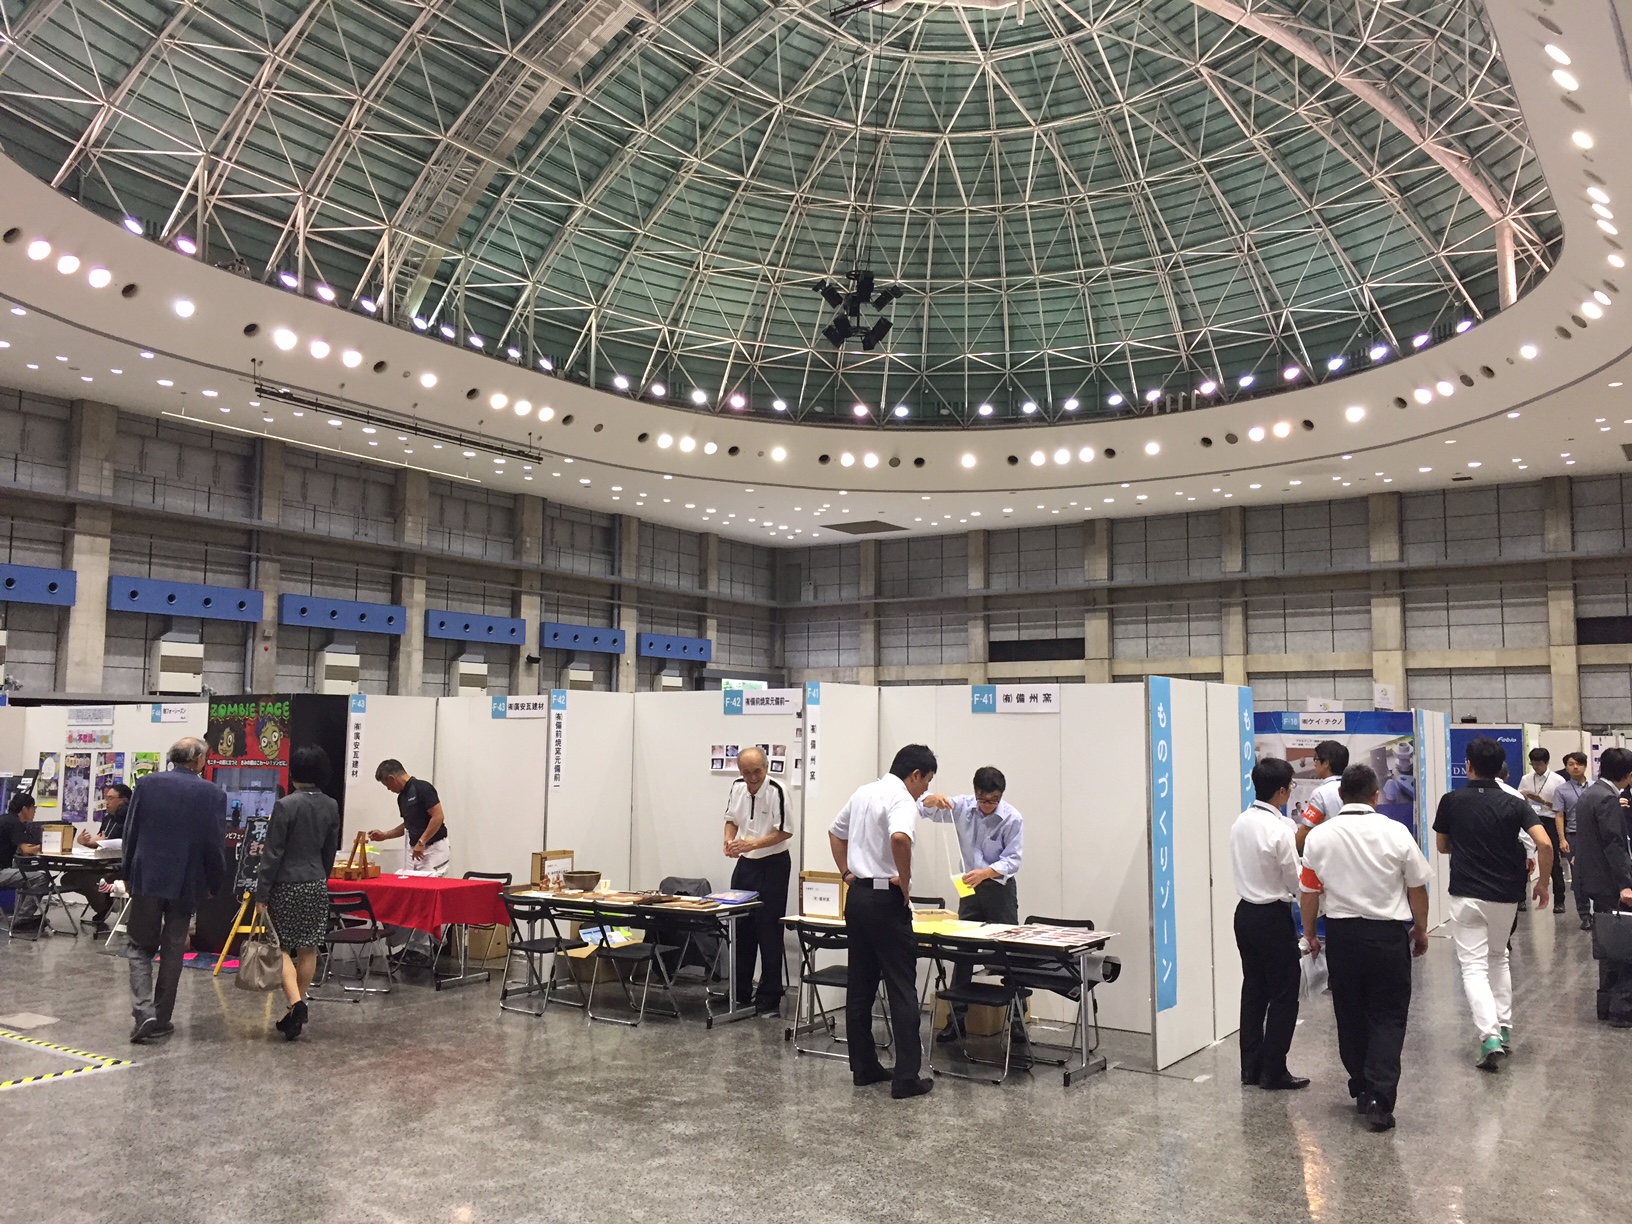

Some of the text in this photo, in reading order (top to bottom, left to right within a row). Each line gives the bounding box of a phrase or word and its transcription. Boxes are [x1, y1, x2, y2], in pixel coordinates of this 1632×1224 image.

[351, 699, 365, 708] F-43
[552, 694, 566, 705] F-42
[725, 697, 741, 707] F-42
[973, 693, 993, 705] F-41
[210, 701, 290, 718] ZOMBIE FACE
[492, 702, 505, 712] F-43
[1157, 702, 1173, 983] ものづくりゾーン
